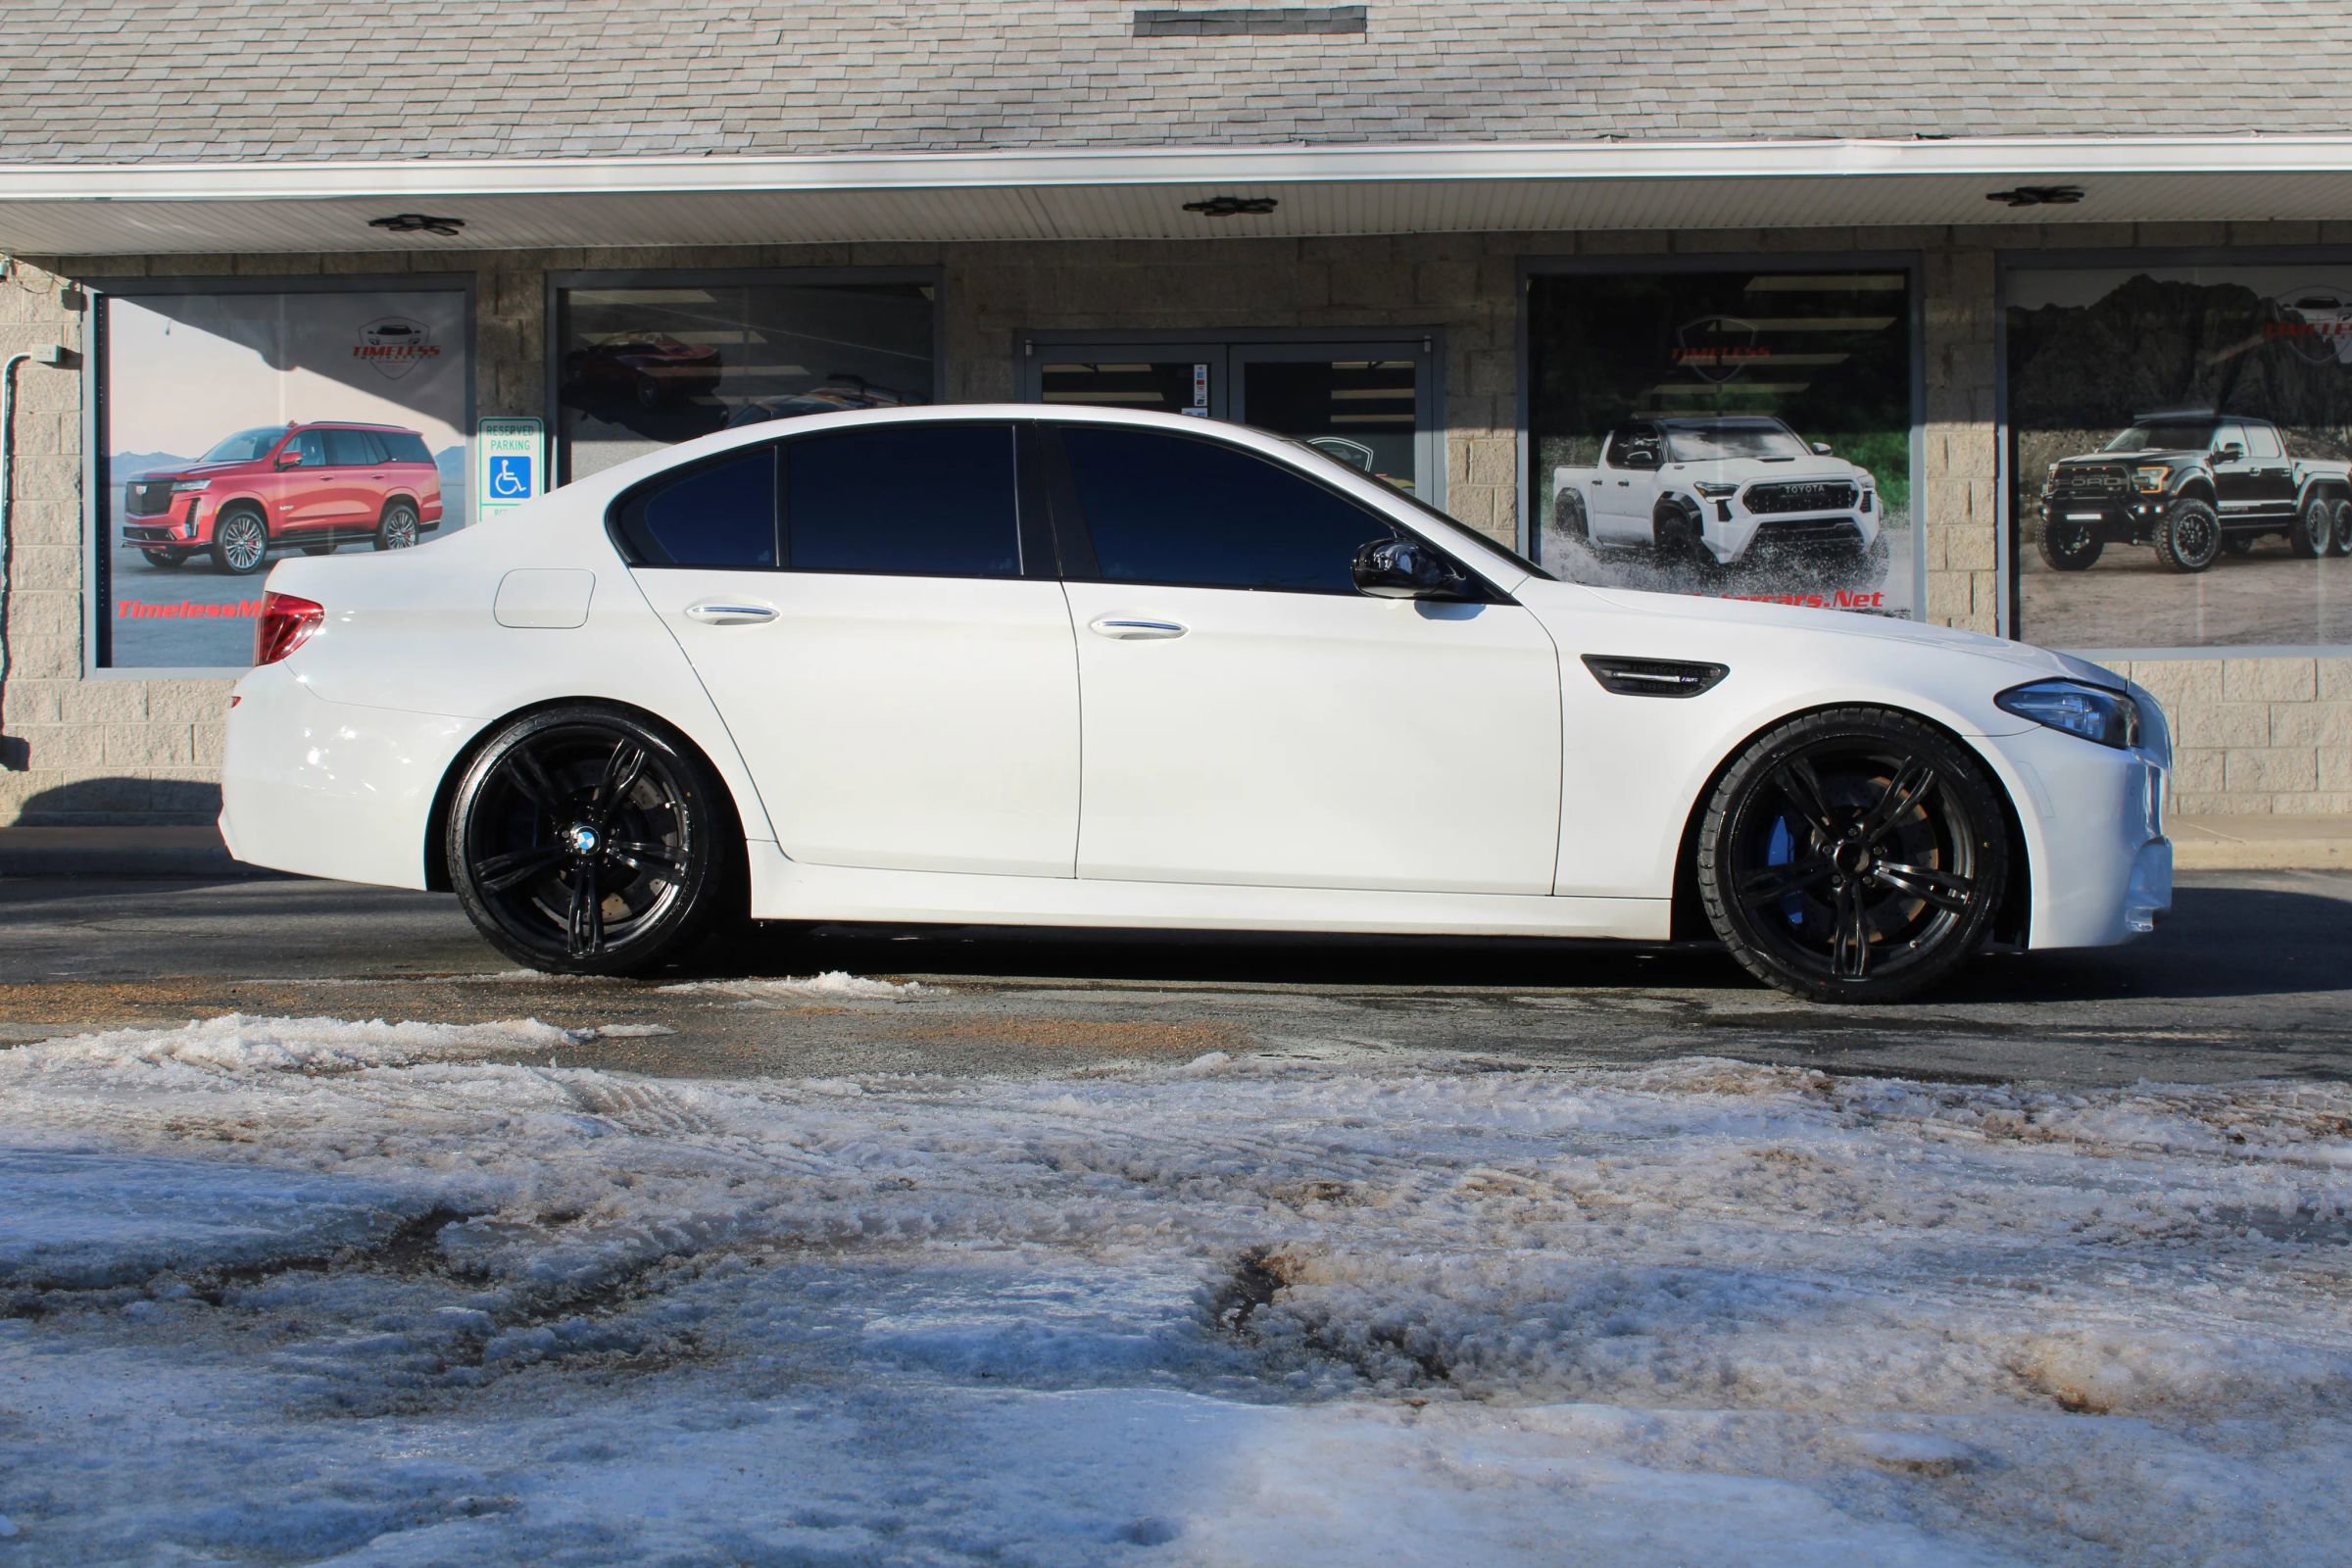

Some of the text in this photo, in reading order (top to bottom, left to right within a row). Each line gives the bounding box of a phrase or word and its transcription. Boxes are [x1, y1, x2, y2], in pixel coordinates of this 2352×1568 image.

[352, 345, 440, 357] TIMELESS
[486, 425, 534, 436] RESERVED
[490, 440, 530, 451] PARKING
[1785, 484, 1825, 494] TOYOTA
